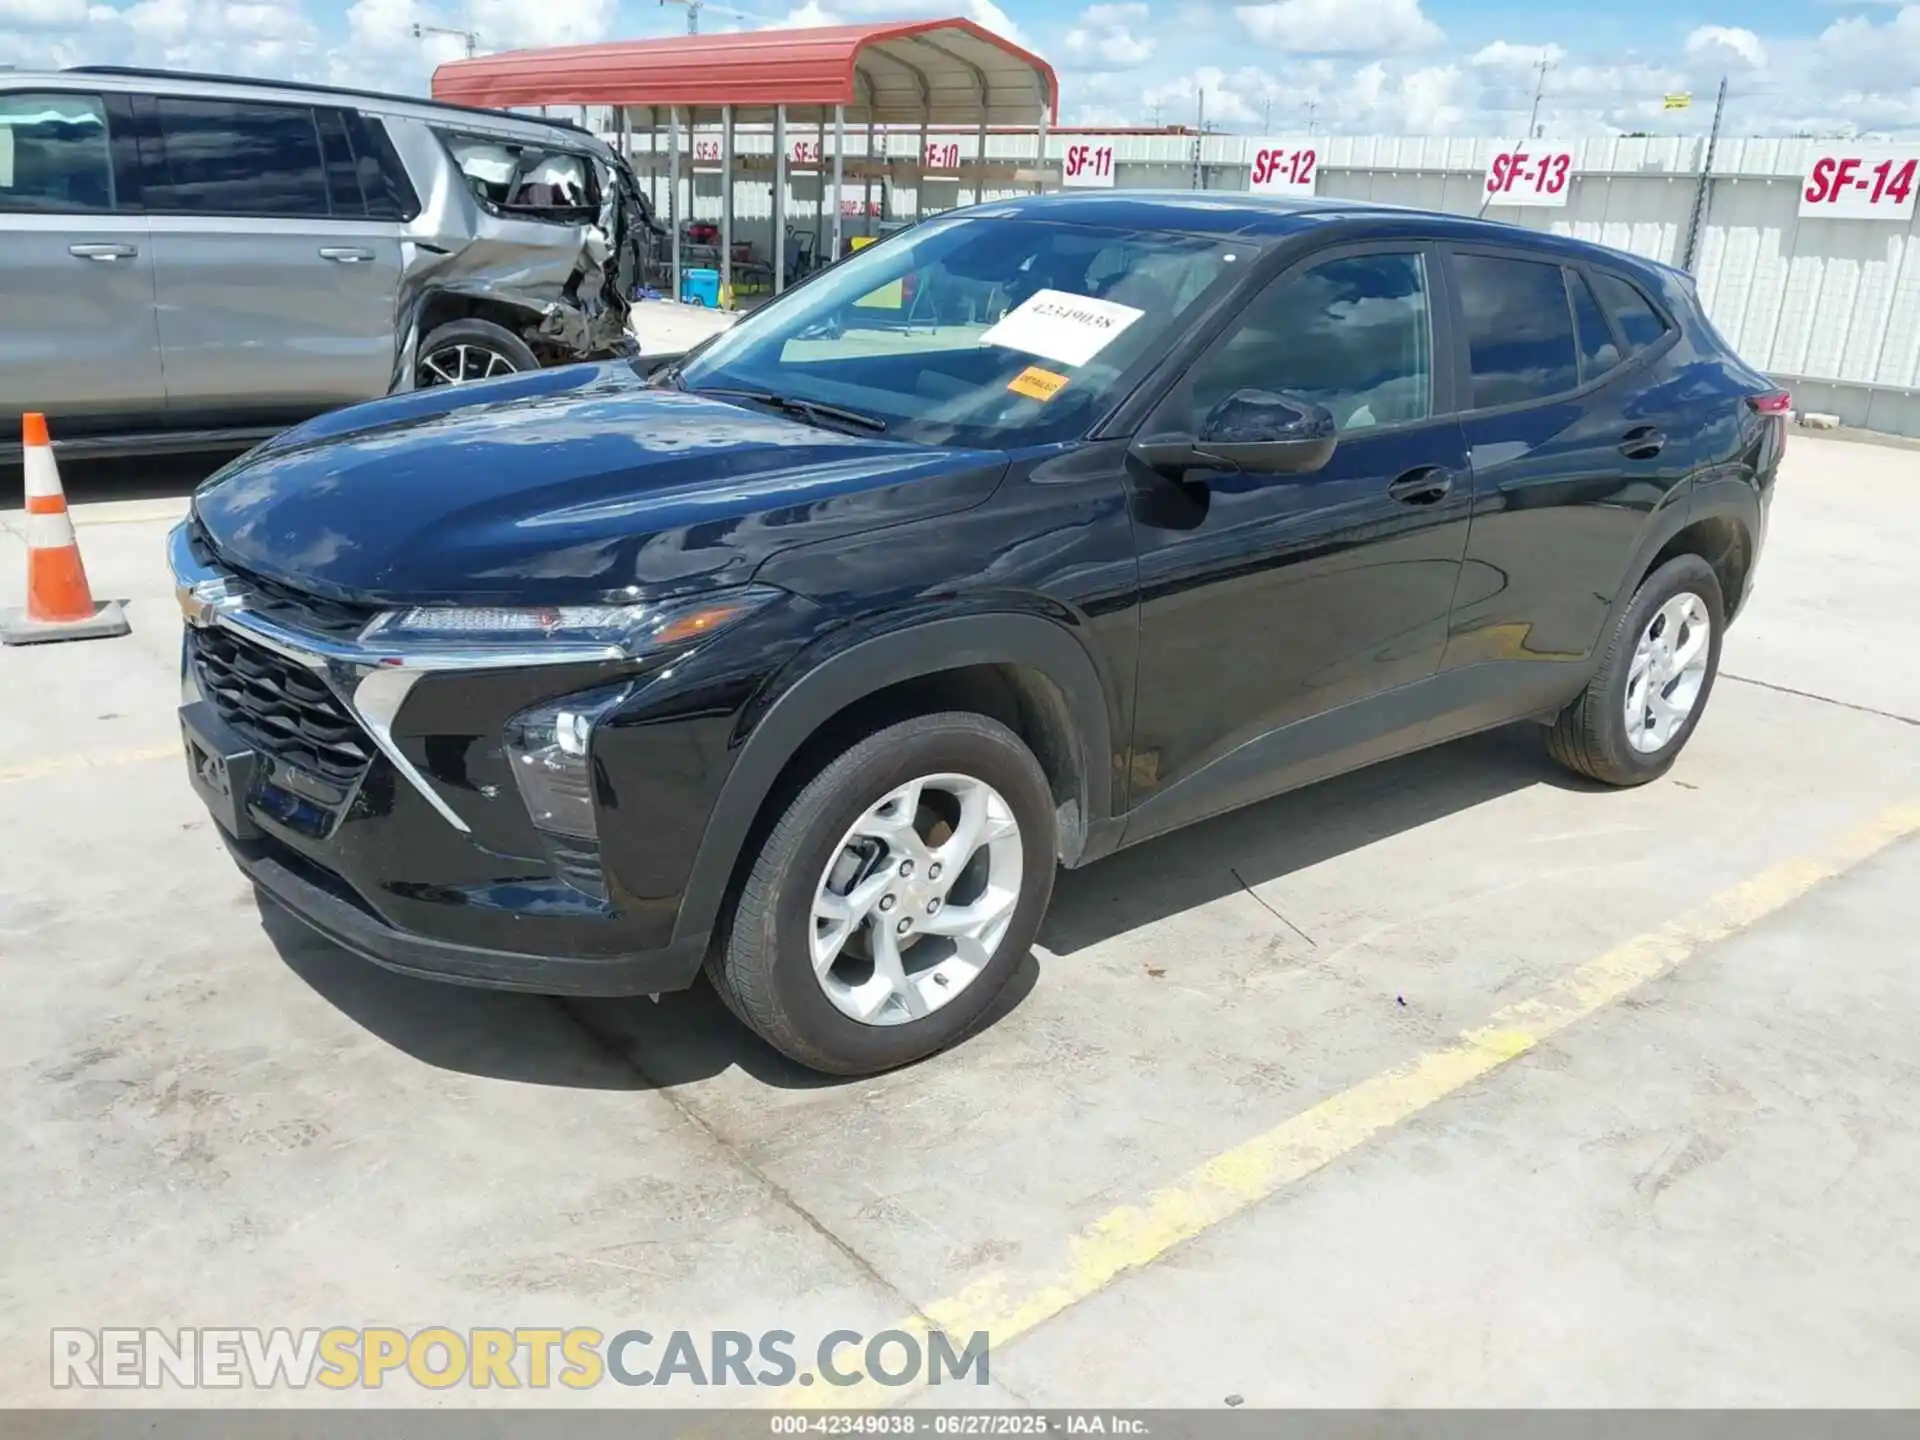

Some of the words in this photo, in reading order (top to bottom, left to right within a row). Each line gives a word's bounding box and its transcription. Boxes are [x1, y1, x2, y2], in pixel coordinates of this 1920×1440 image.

[1066, 145, 1113, 177] SF-11
[1252, 149, 1316, 184] SF-12
[1486, 152, 1571, 194] SF-13
[1805, 158, 1919, 204] SF-14
